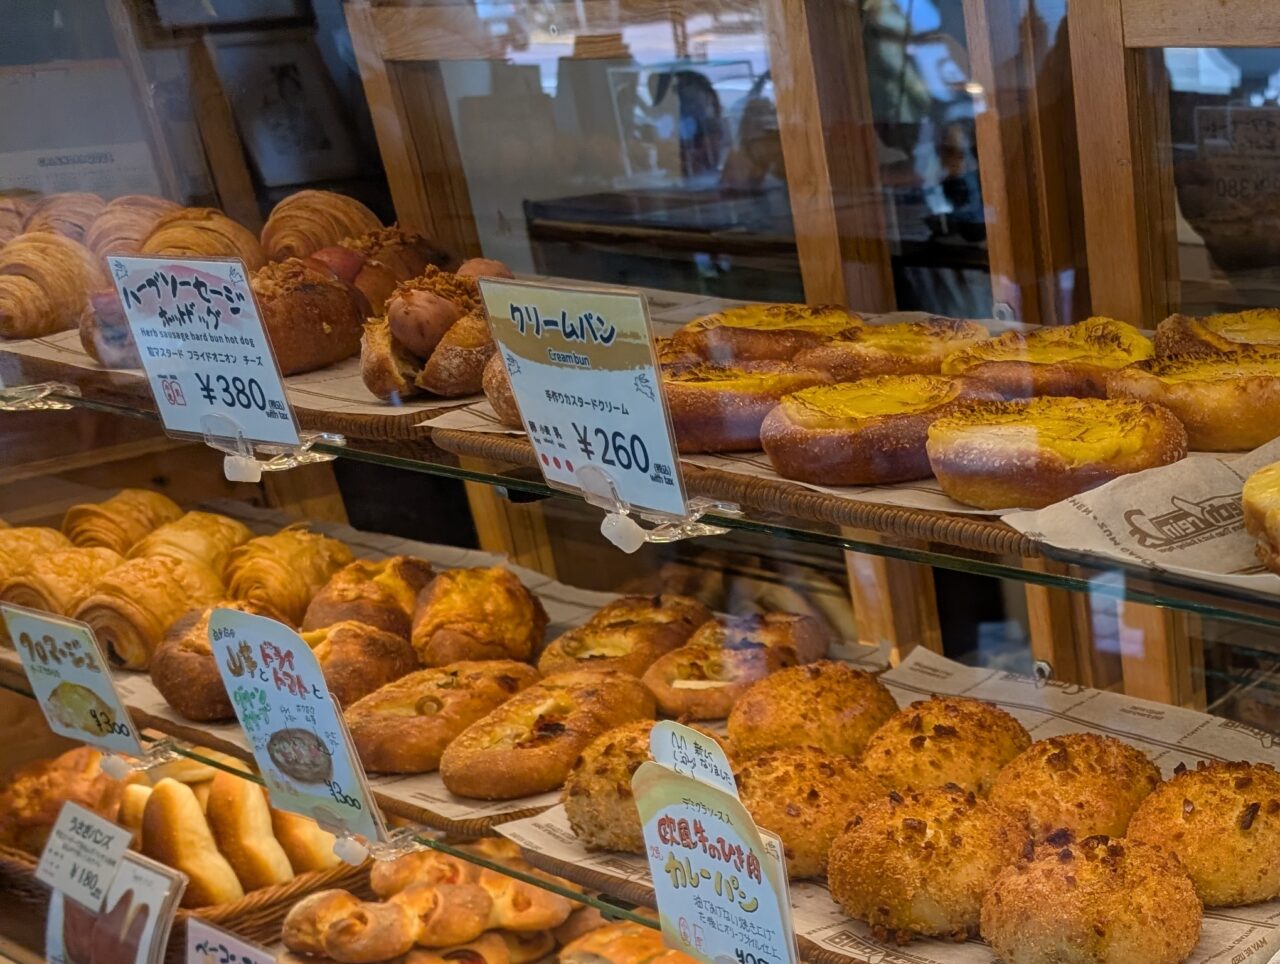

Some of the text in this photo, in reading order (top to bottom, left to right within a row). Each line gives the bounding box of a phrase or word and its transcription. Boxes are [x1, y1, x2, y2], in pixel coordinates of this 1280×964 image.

[510, 303, 616, 344] クリームパン
[140, 328, 255, 348] Herb sausage hard bun hot dog
[242, 355, 264, 366] チーズ
[549, 349, 591, 367] Cream bun
[195, 372, 267, 411] ¥380
[545, 389, 629, 415] 手作りカスタードクリーム
[571, 422, 650, 474] ¥260
[649, 474, 675, 486] with tax
[664, 851, 759, 913] カレーパン
